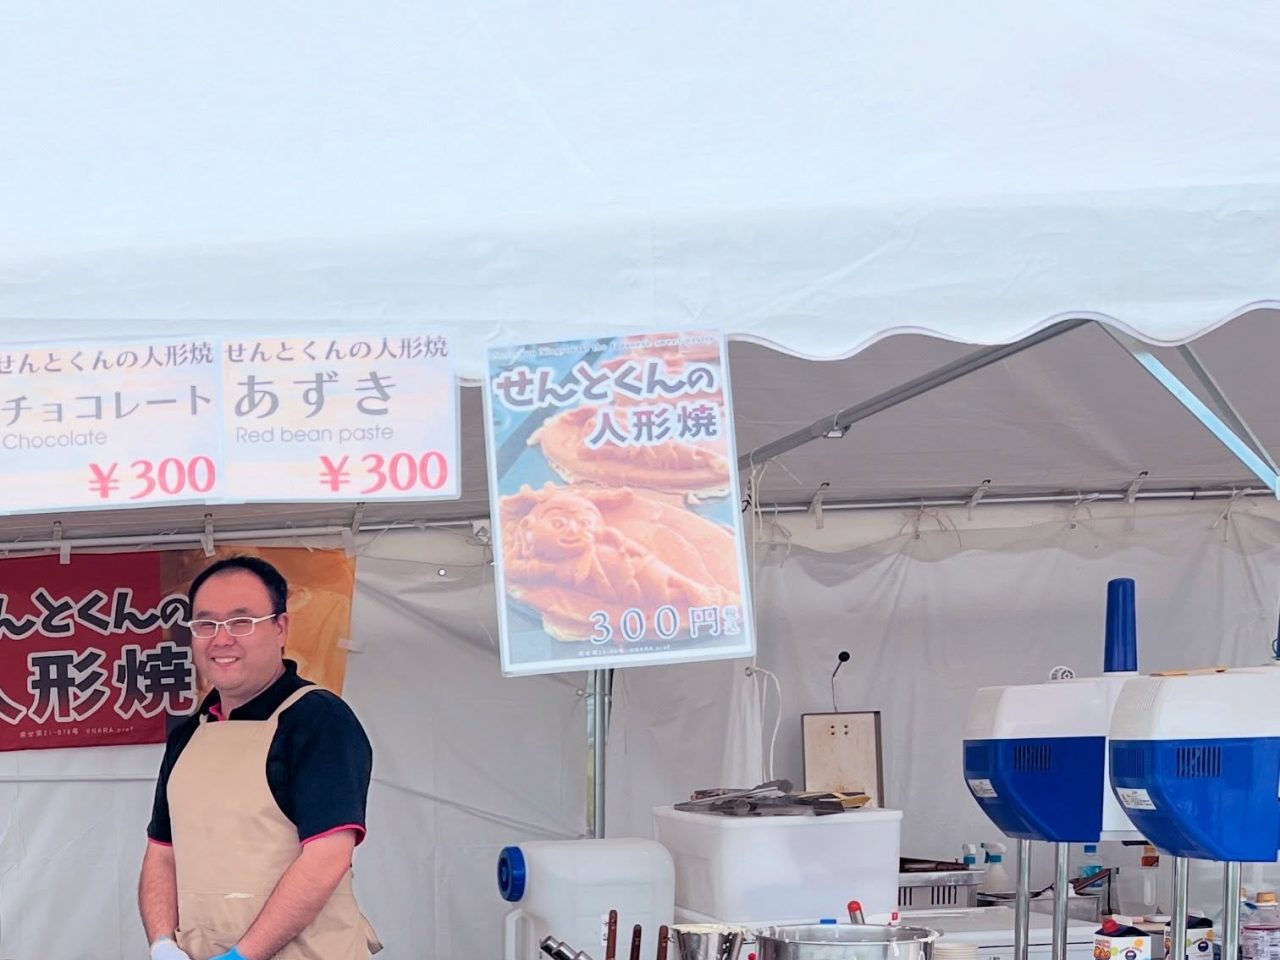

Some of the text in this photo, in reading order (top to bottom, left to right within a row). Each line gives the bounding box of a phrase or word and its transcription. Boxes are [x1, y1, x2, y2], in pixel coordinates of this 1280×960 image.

[224, 335, 449, 364] せんとくんの人形焼
[0, 383, 212, 427] チョコレート
[235, 370, 396, 419] あずき
[497, 362, 714, 407] せんとくんの
[2, 428, 108, 451] Chocolate
[236, 423, 394, 445] Red bean paste
[589, 404, 718, 446] 人形焼
[87, 456, 217, 499] ¥300
[319, 451, 448, 494] ¥300
[590, 607, 718, 644] 300円
